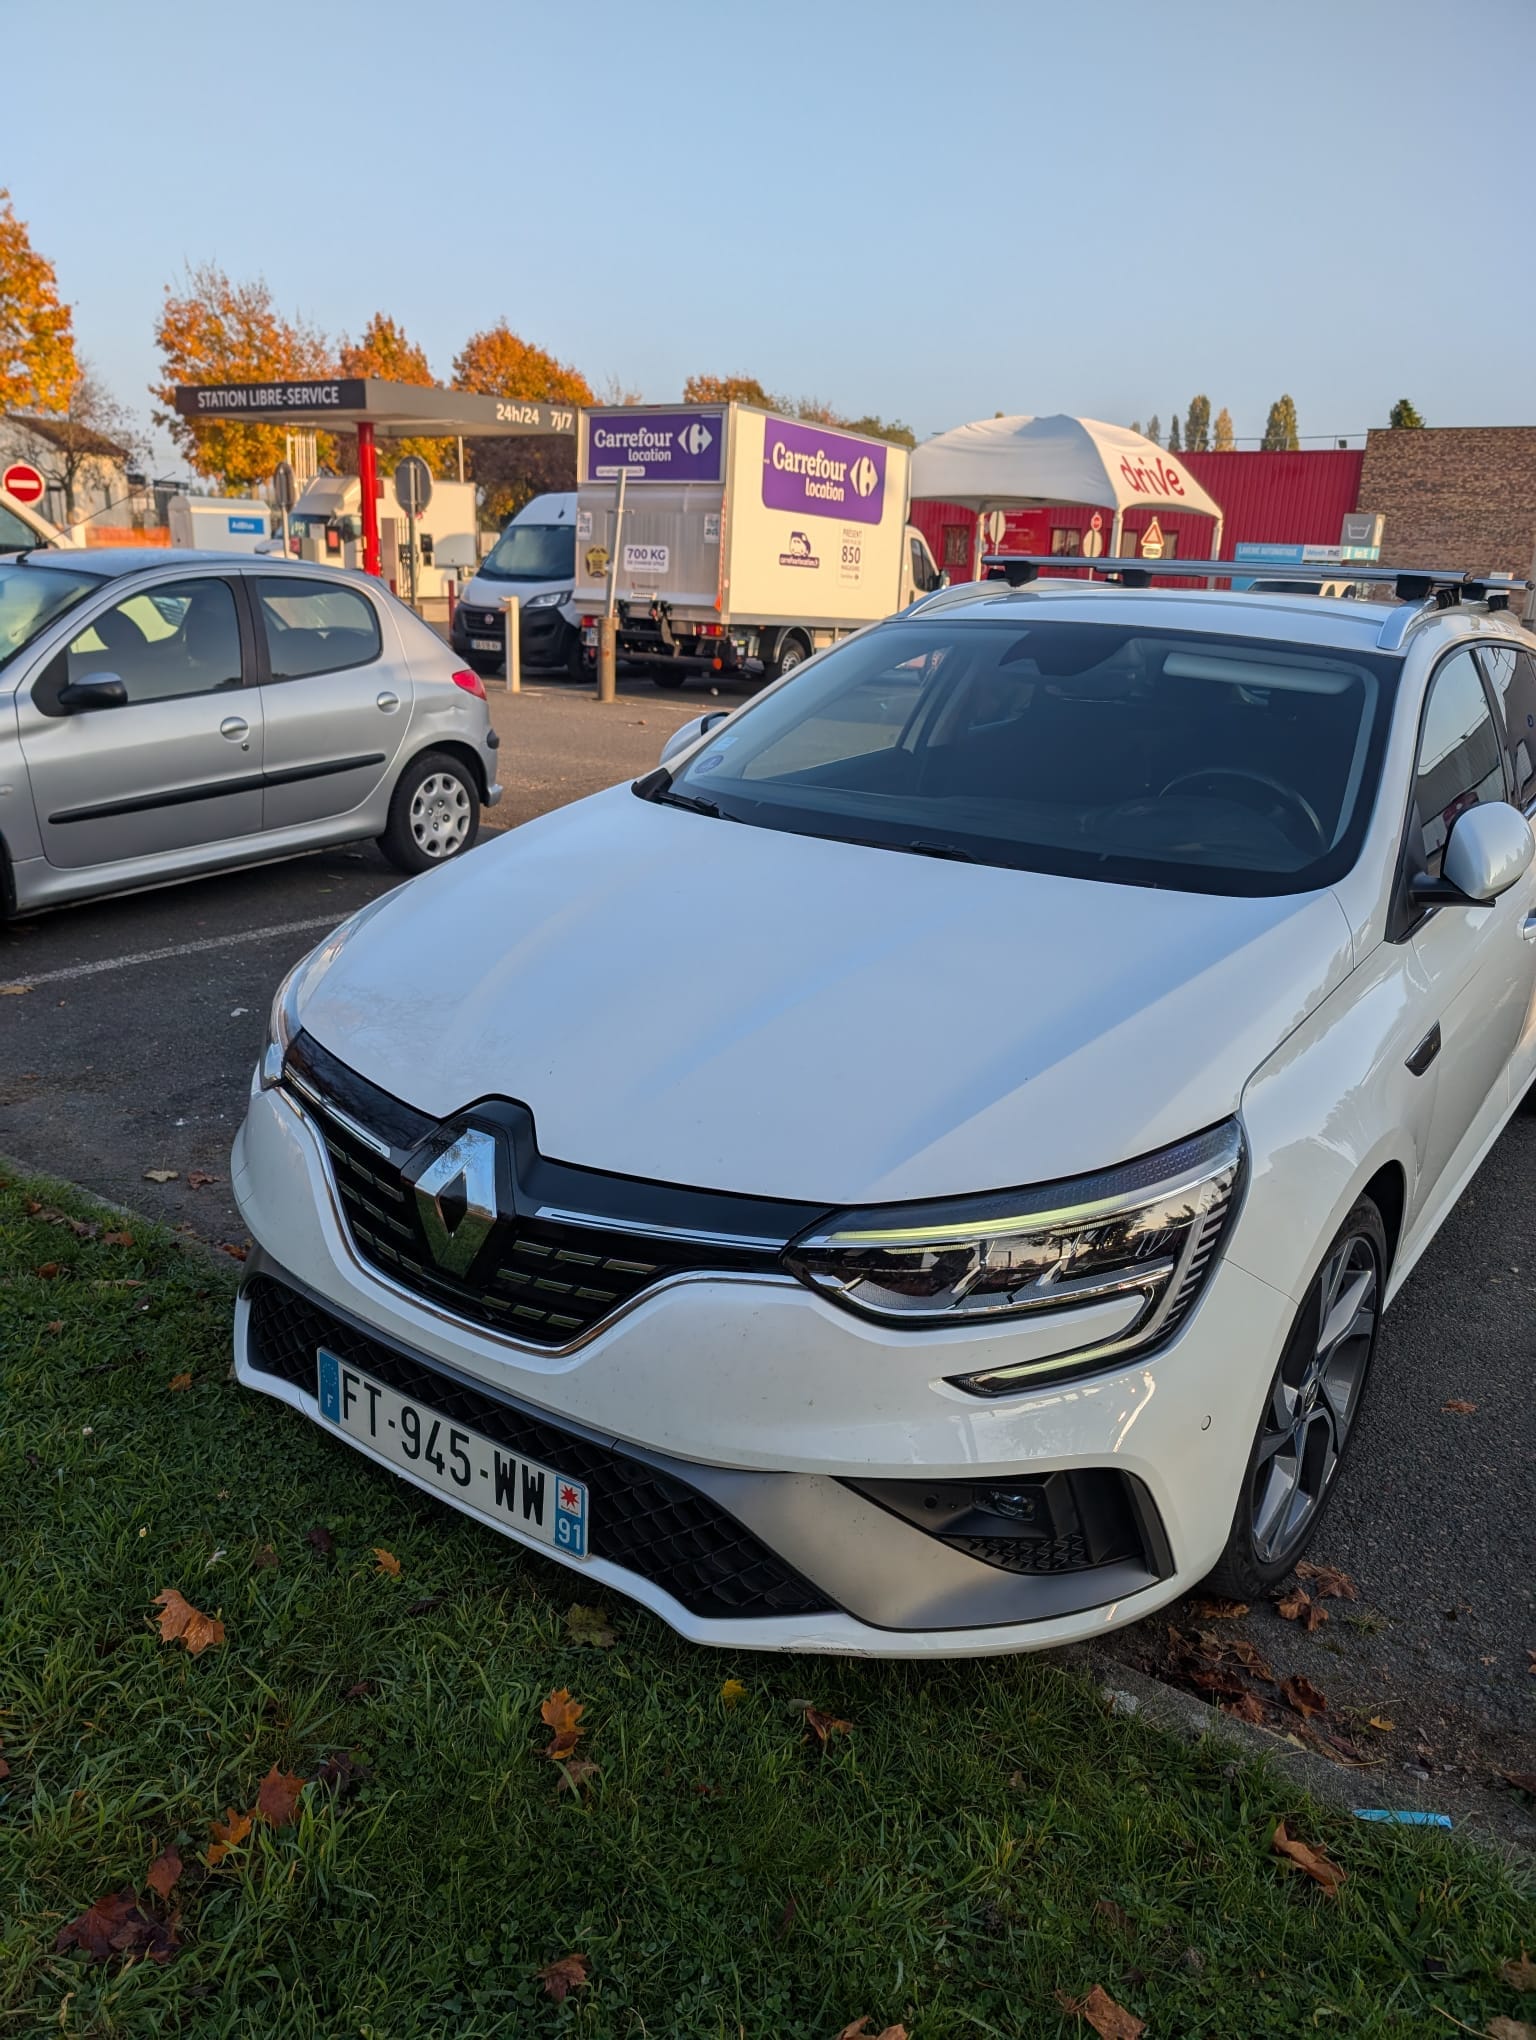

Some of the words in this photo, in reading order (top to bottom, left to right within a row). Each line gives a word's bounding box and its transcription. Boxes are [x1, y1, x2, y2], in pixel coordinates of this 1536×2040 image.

[198, 390, 248, 408] STATION
[249, 386, 340, 406] LIBRE-SERVICE
[496, 403, 540, 425] 24h/24
[550, 410, 573, 431] 7j/7
[594, 427, 673, 448] Carrefour
[628, 448, 672, 462] location
[772, 441, 847, 482] Carrefour
[1120, 455, 1185, 496] drive
[804, 477, 845, 502] location
[627, 548, 648, 560] 700
[650, 549, 667, 561] KG
[841, 545, 861, 564] 850
[327, 1393, 334, 1408] F
[342, 1369, 545, 1526] FT-945-WW
[558, 1518, 581, 1550] 91
